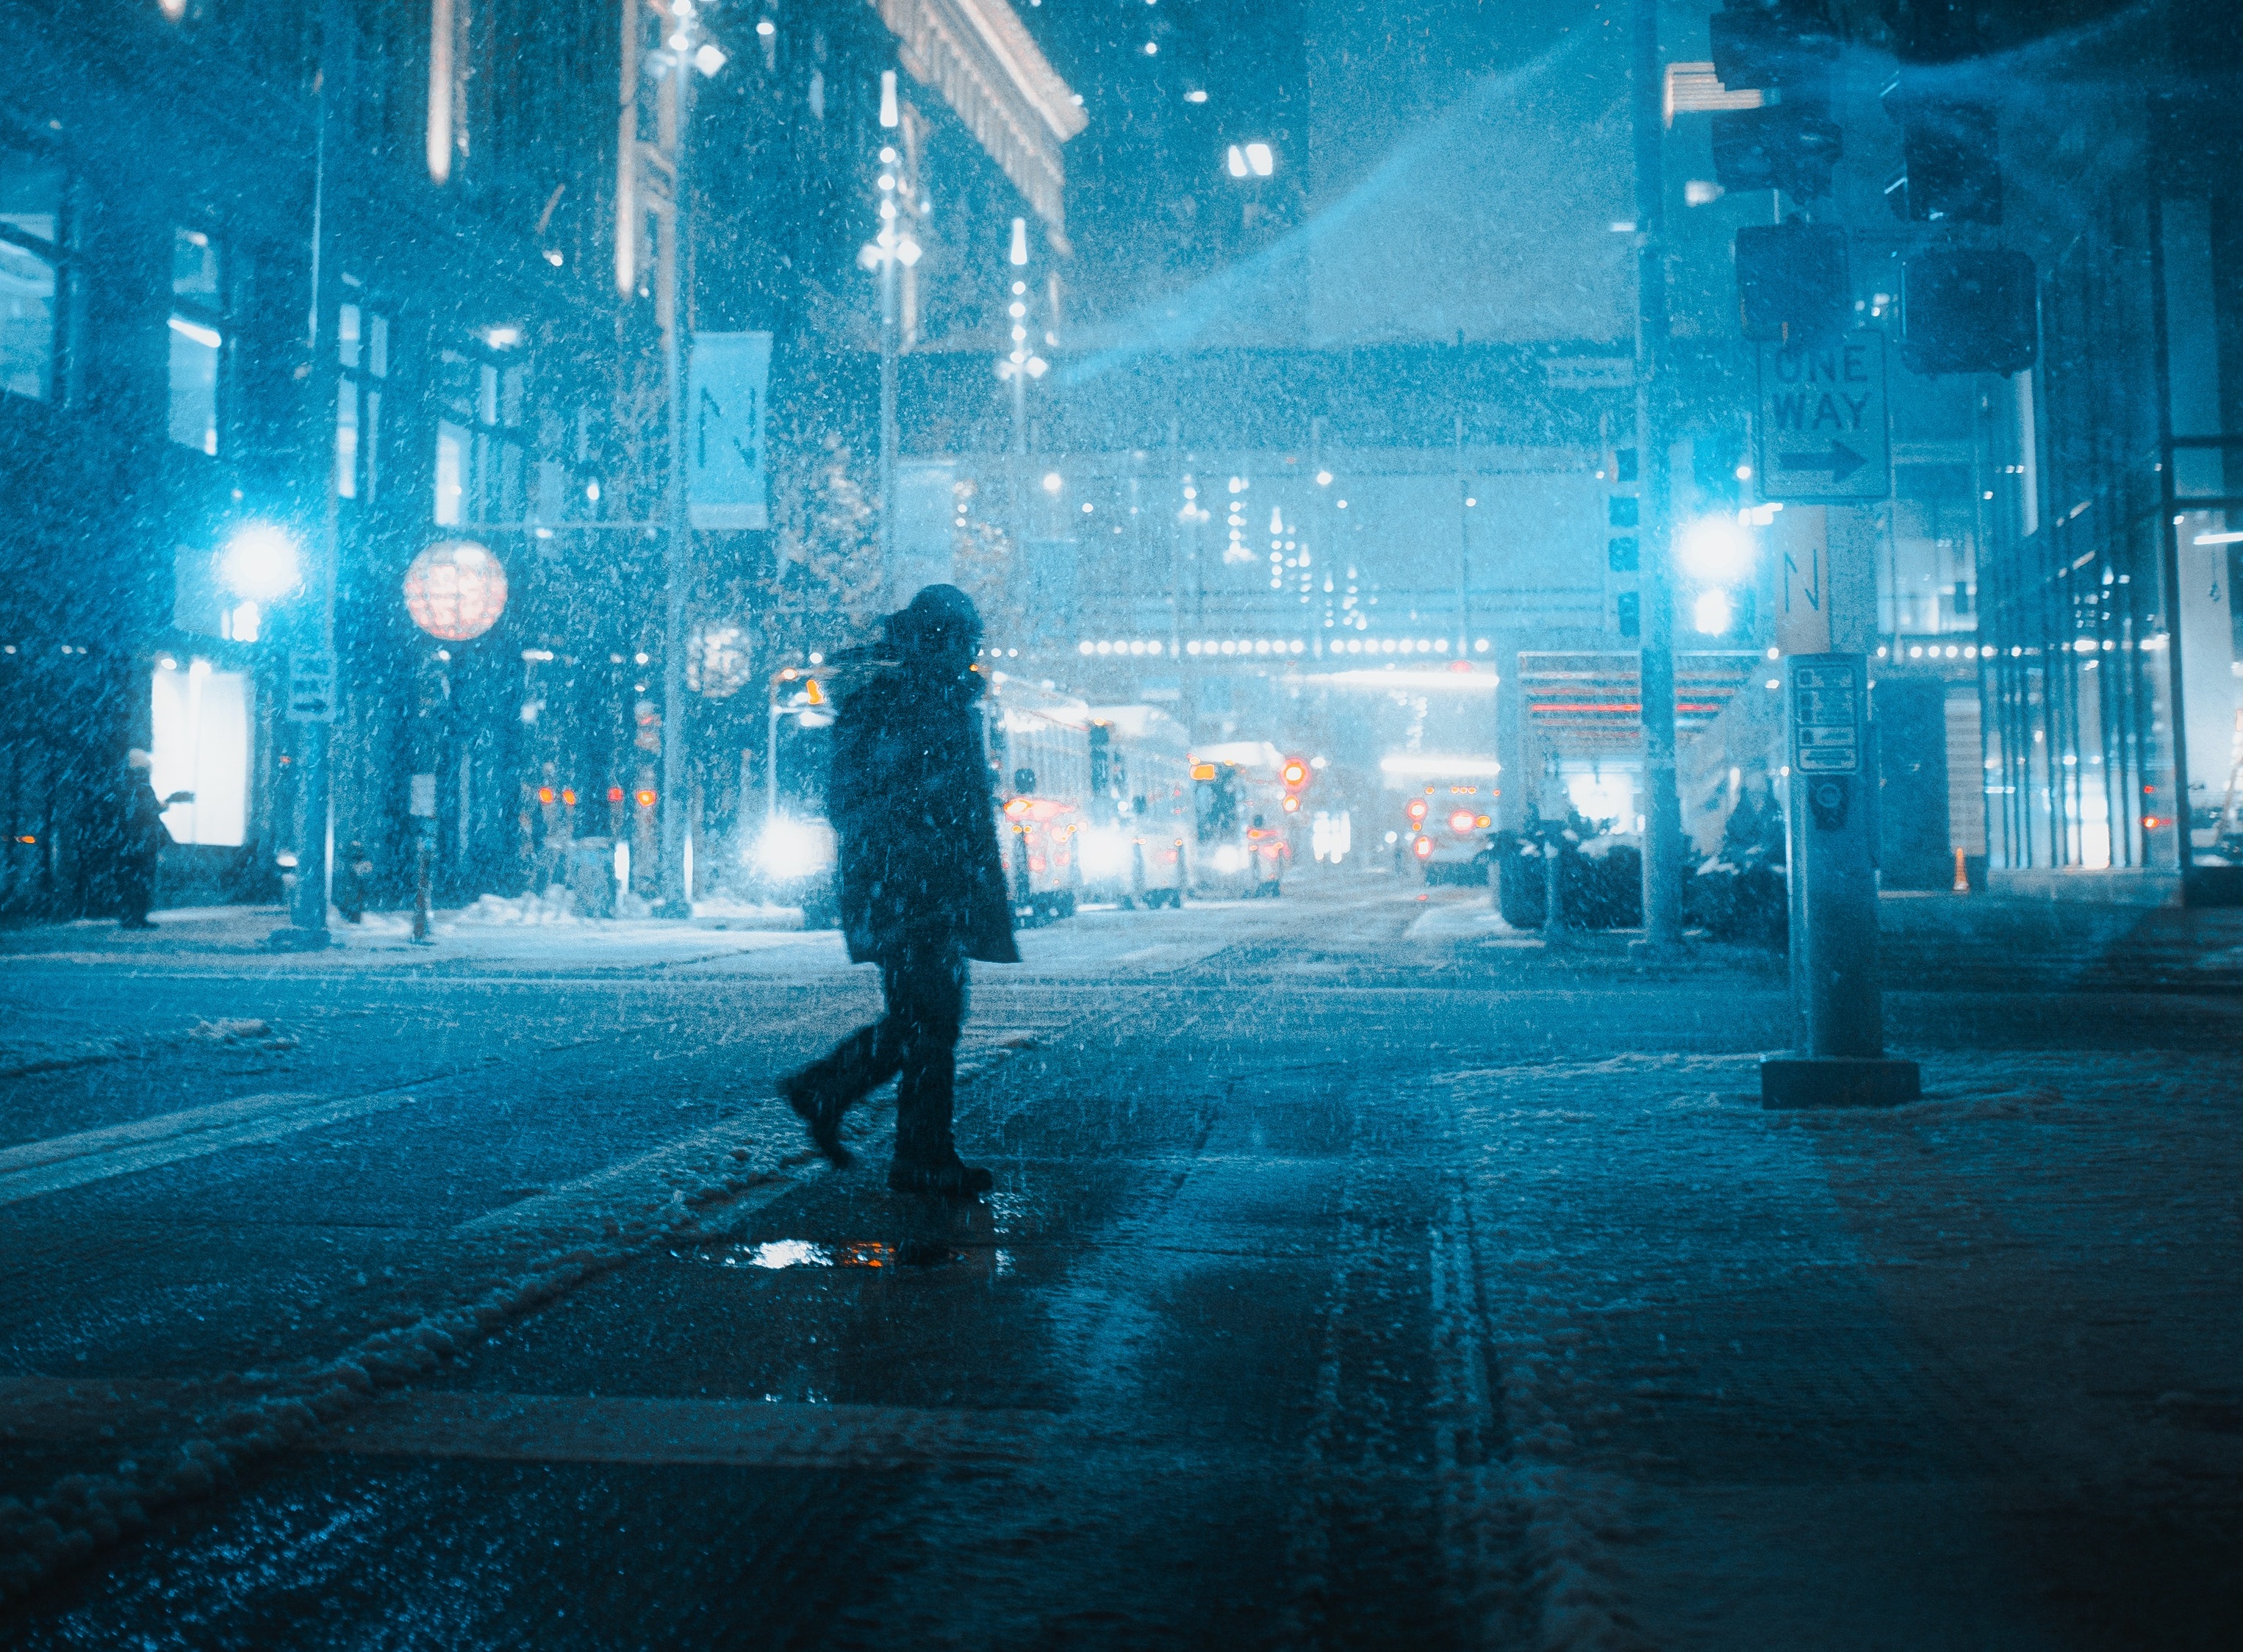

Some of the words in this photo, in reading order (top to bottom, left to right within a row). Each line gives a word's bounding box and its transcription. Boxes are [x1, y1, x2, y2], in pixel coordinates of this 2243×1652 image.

[1775, 345, 1868, 384] ONE
[1773, 392, 1872, 430] WAY
[1783, 548, 1820, 614] N
